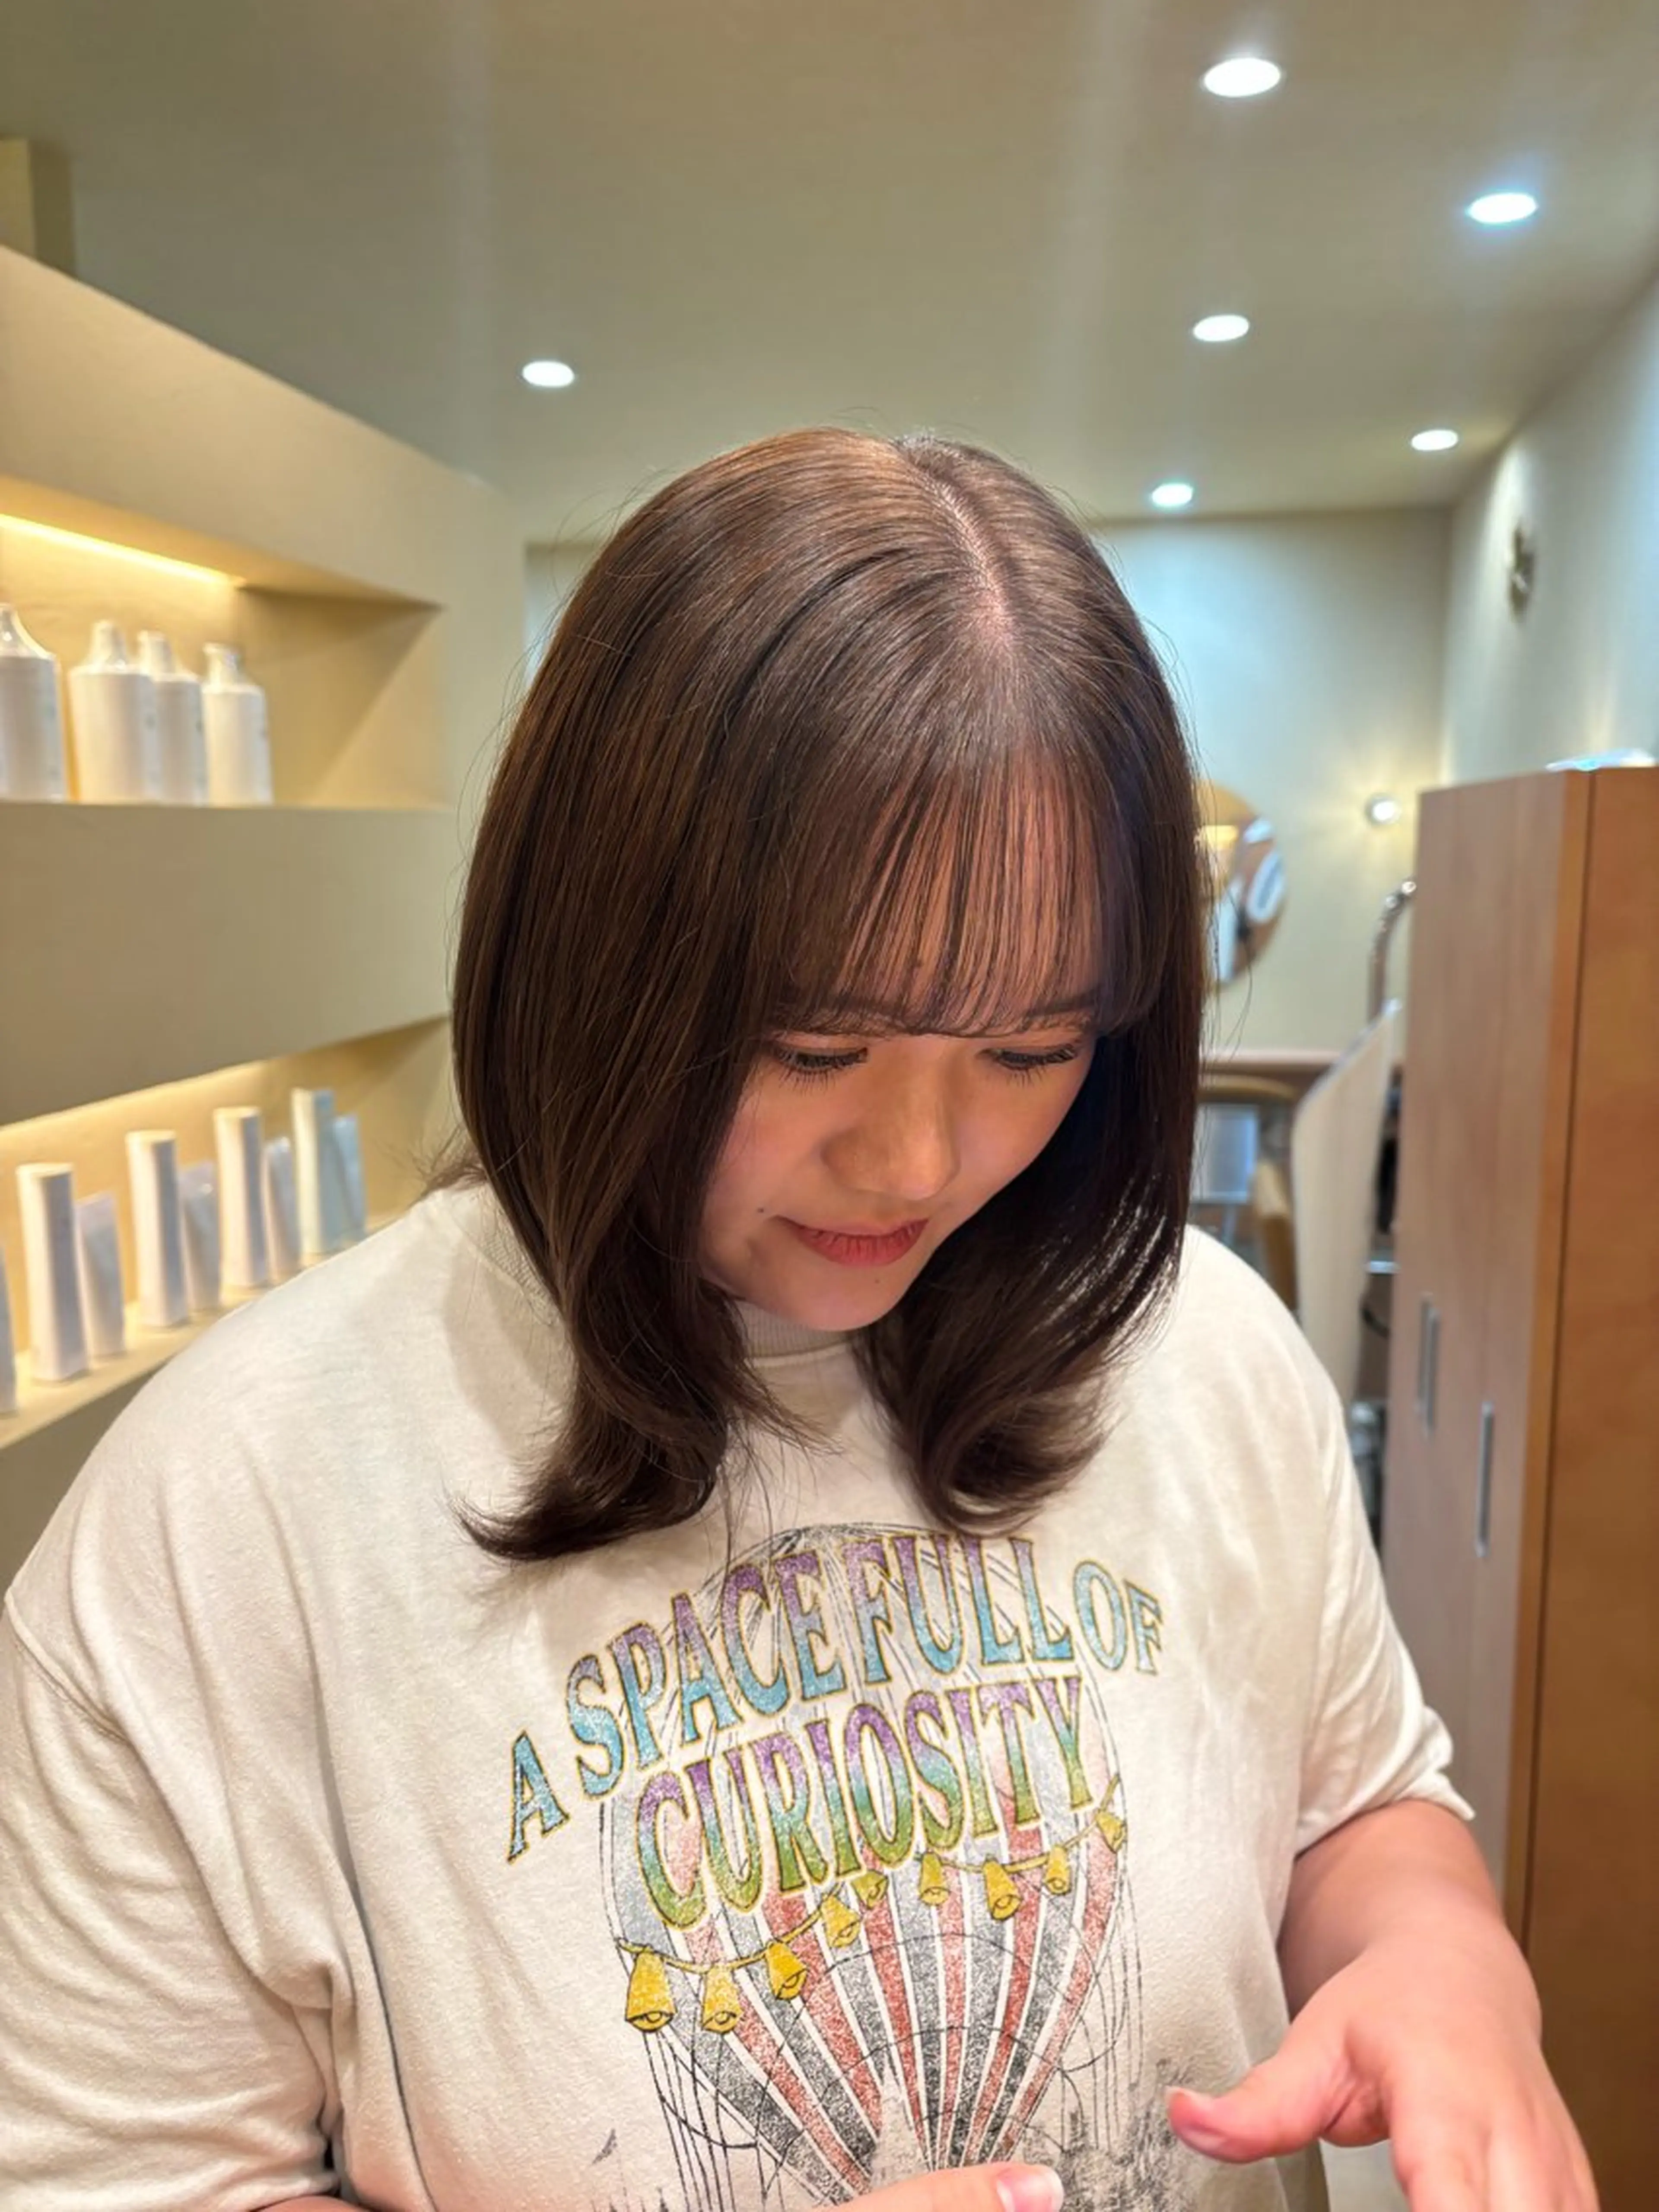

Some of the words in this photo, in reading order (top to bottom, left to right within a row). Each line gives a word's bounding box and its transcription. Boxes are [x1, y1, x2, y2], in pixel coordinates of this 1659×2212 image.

[505, 1729, 568, 1864] A
[566, 1551, 843, 1802] SPACE
[841, 1534, 1076, 1685] FULL
[1073, 1560, 1163, 1675] OF
[636, 1676, 1097, 1930] CURIOSITY
